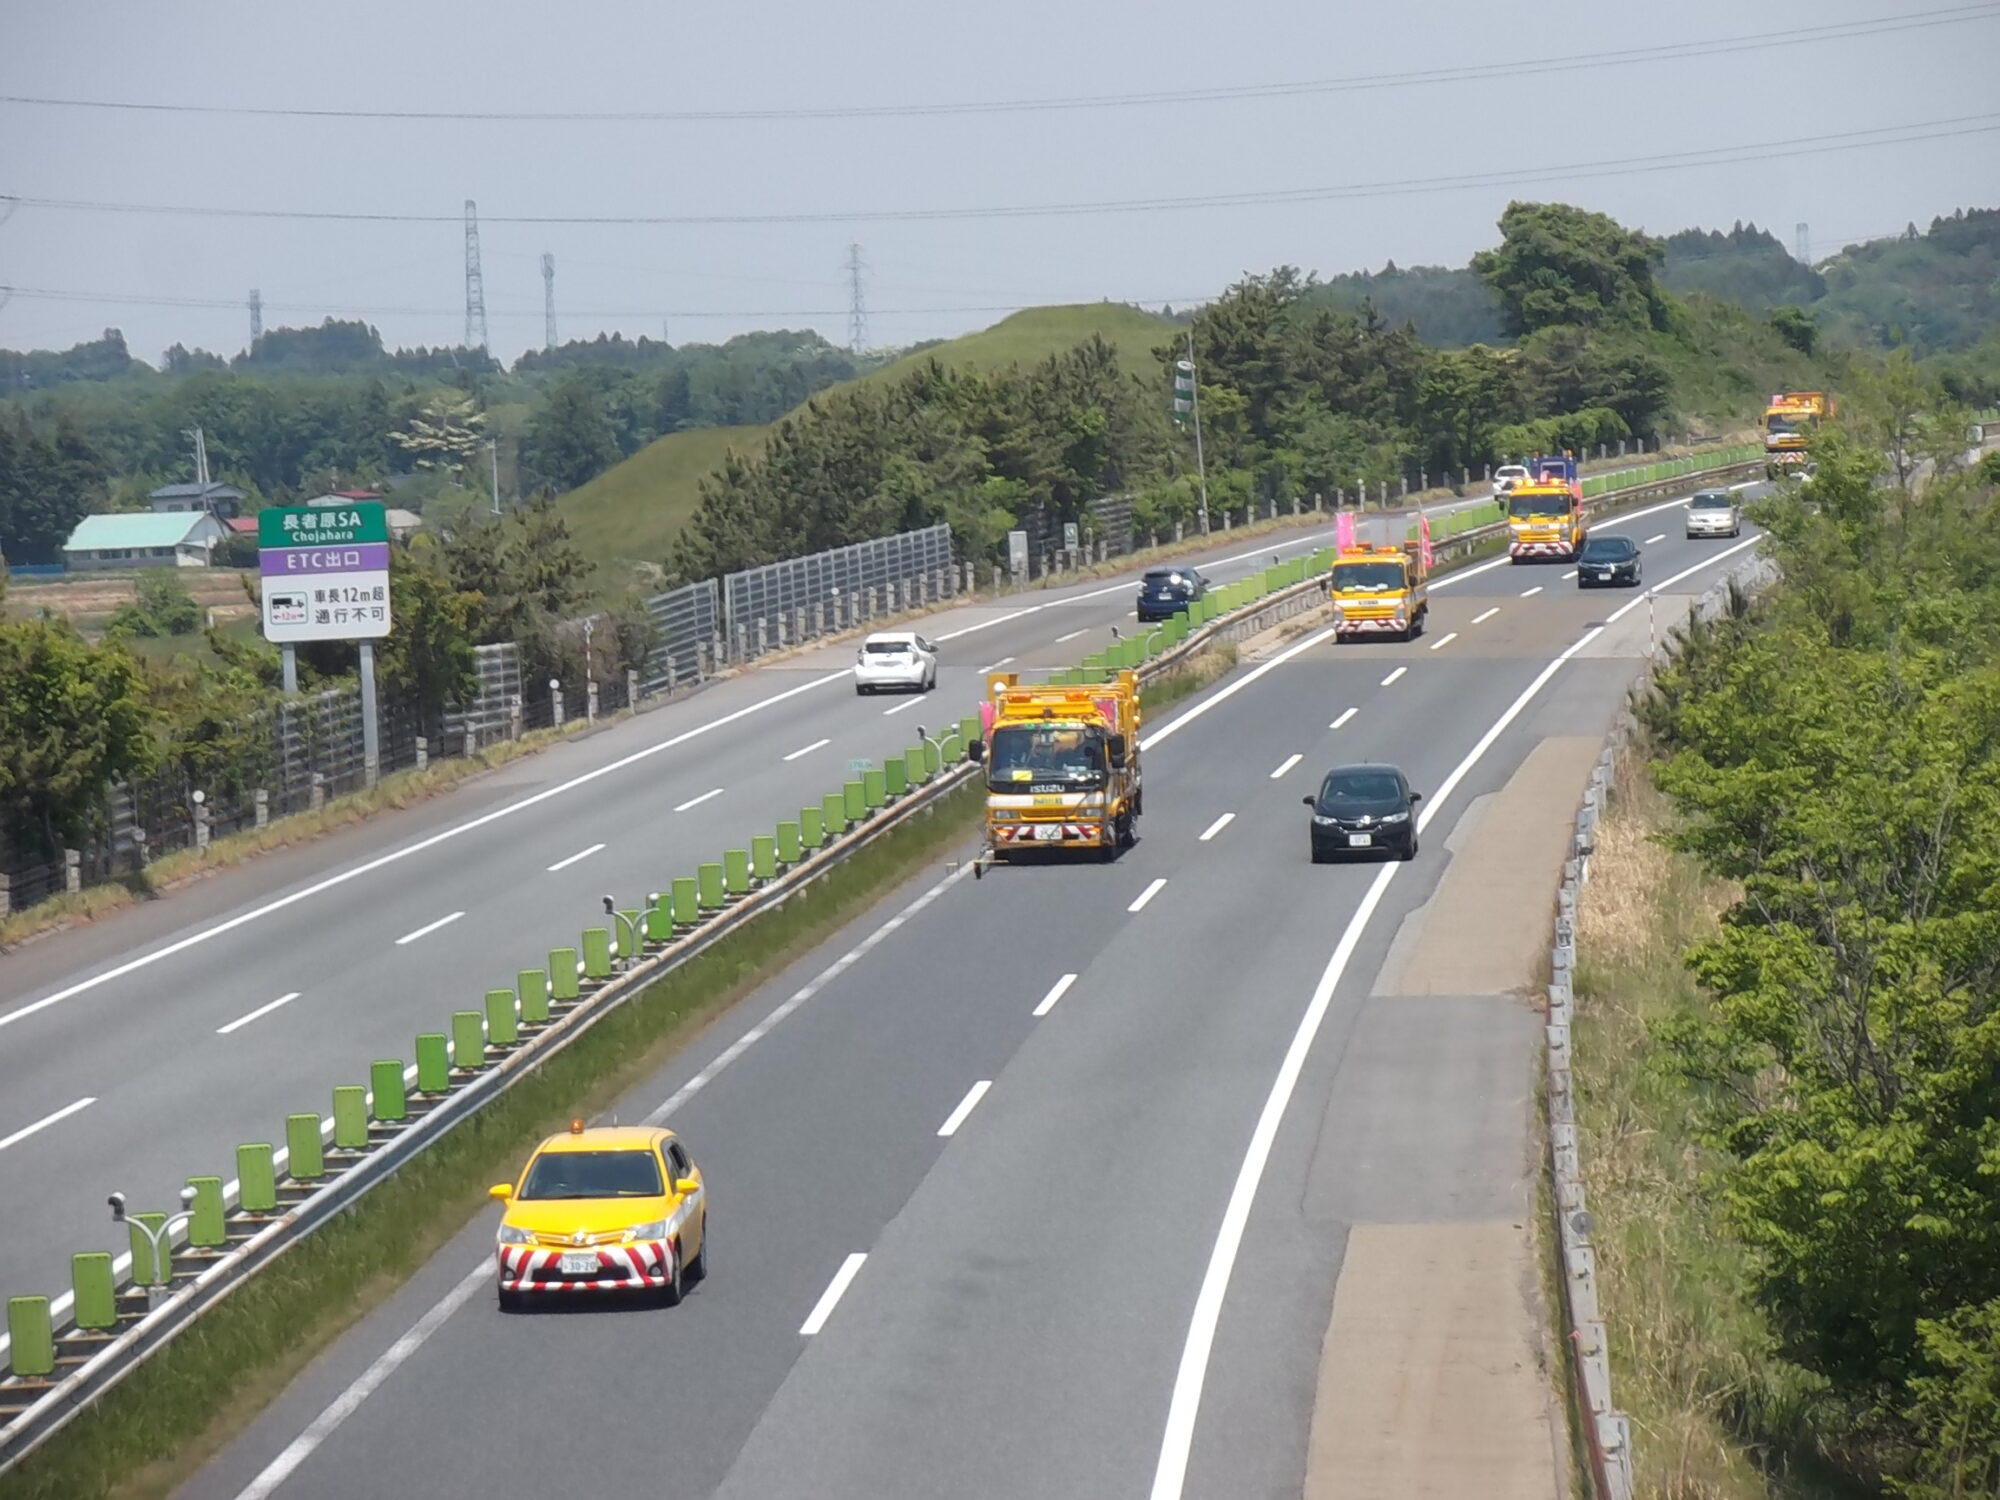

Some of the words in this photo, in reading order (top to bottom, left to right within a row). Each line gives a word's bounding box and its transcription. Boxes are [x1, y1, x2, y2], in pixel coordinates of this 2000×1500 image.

[283, 511, 361, 530] 長者原SA
[292, 530, 353, 543] Chojahara
[287, 551, 360, 569] ETC出口
[314, 586, 384, 603] 車長12m超
[315, 606, 384, 624] 通行不可
